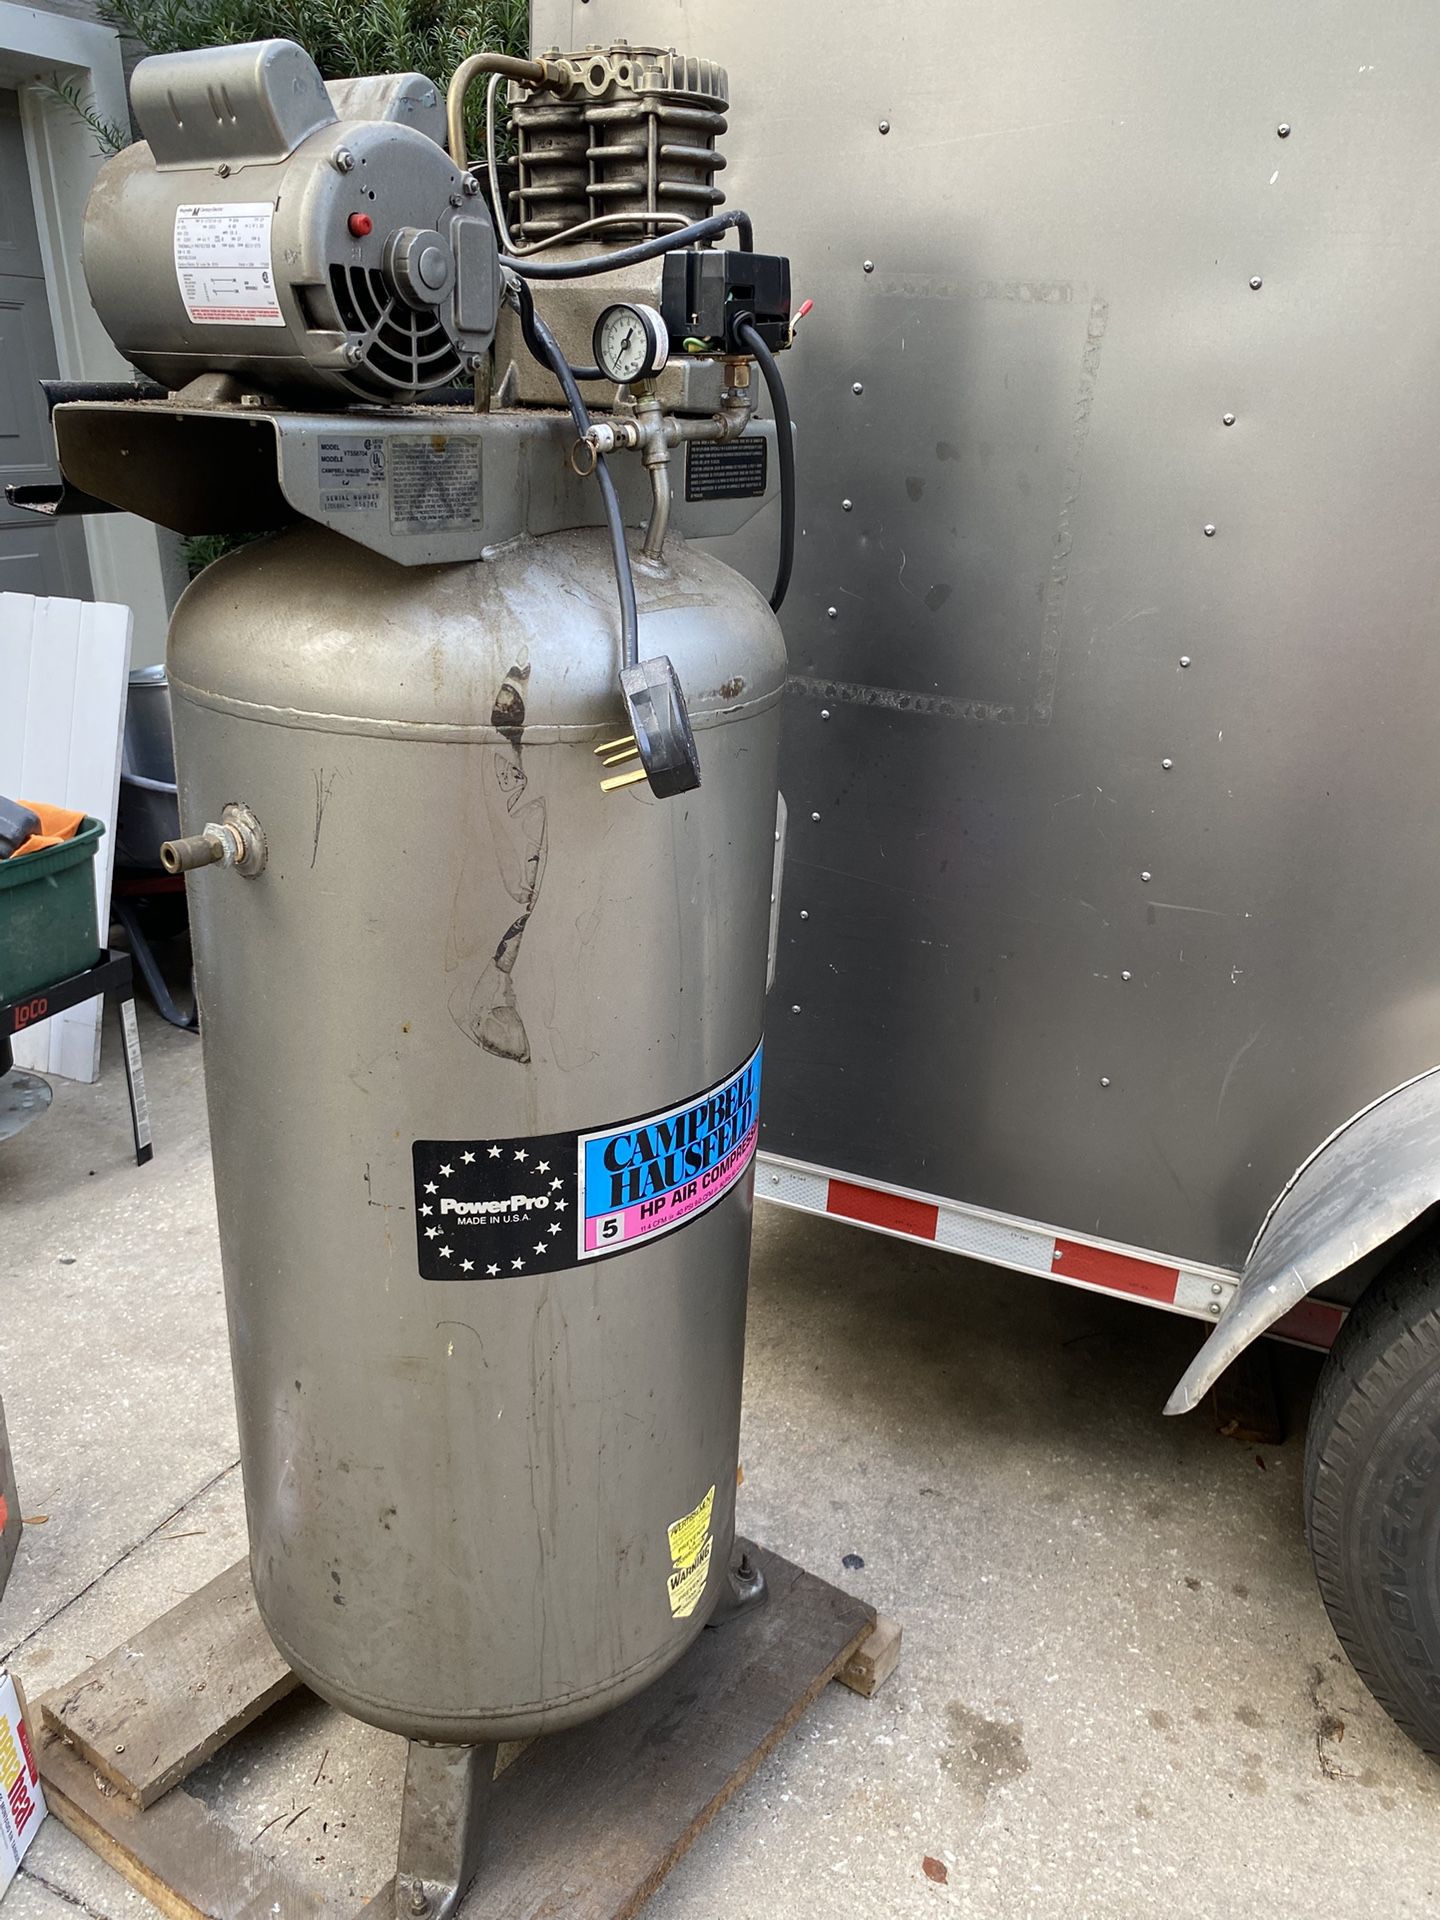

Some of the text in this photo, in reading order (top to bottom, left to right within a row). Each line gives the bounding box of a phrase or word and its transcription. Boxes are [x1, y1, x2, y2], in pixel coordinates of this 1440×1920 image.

[603, 1063, 755, 1173] CAMPBELL
[609, 1100, 753, 1209] HAUSFELD
[440, 1195, 550, 1215] PowerPro
[457, 1213, 531, 1225] MADE IN U.S.A.
[602, 1218, 618, 1239] 5
[640, 1200, 666, 1220] HP
[671, 1182, 697, 1208] AIR
[653, 1216, 667, 1228] CFM
[684, 1203, 694, 1213] PSI
[670, 1544, 710, 1590] WARNING
